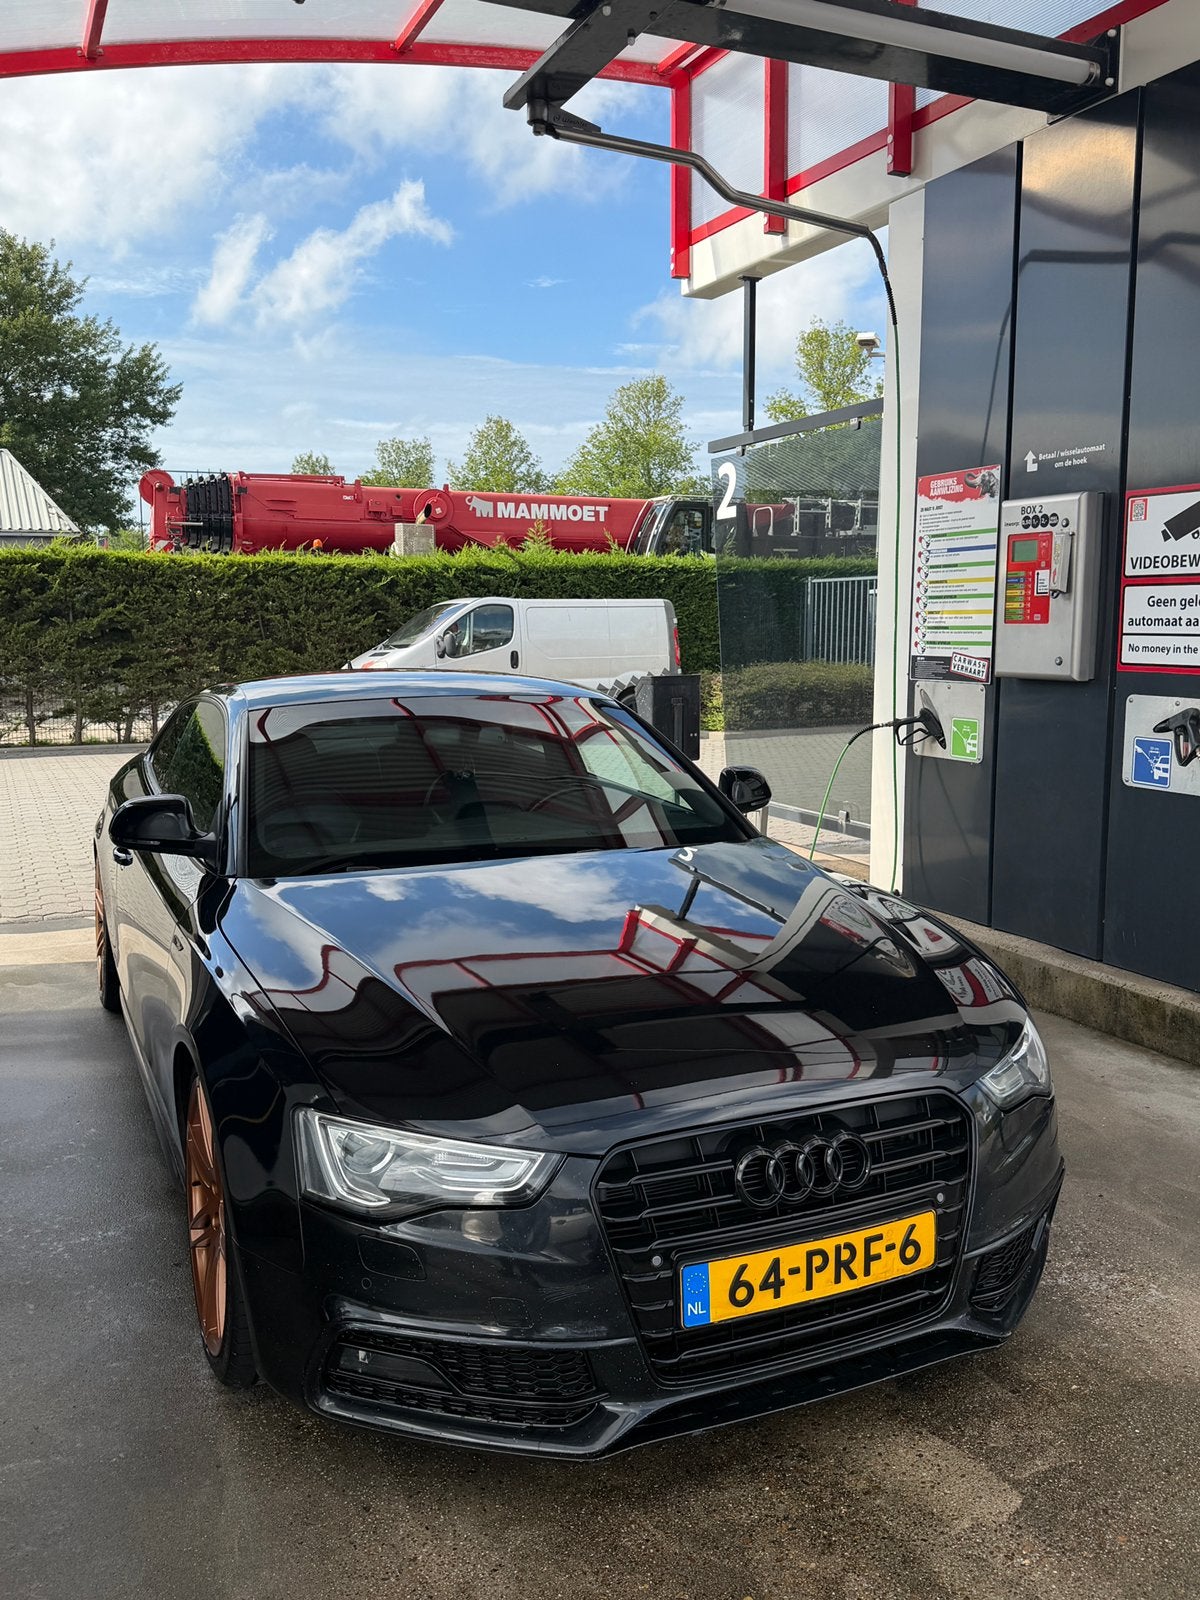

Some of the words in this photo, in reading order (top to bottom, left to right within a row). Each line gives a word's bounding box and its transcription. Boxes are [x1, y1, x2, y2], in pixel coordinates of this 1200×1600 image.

[1038, 450, 1057, 461] Betaal
[1060, 443, 1106, 457] wisselautomaat
[1064, 458, 1072, 467] de
[1072, 456, 1088, 466] hoek
[929, 477, 958, 489] GEBRUIKS
[716, 461, 737, 520] 2
[929, 484, 964, 497] AANWIJZING
[497, 502, 608, 522] MAMMOET
[1020, 505, 1038, 515] BOX
[1038, 504, 1044, 514] 2
[1147, 595, 1177, 608] Geen
[1128, 616, 1183, 627] automaat
[1128, 643, 1140, 653] No
[1142, 646, 1171, 656] money
[1172, 644, 1182, 654] in
[1183, 644, 1199, 655] the
[953, 655, 986, 670] CARWASH
[952, 662, 986, 678] VERHAART
[728, 1223, 922, 1308] 64-PRF-6
[687, 1301, 706, 1317] NL
